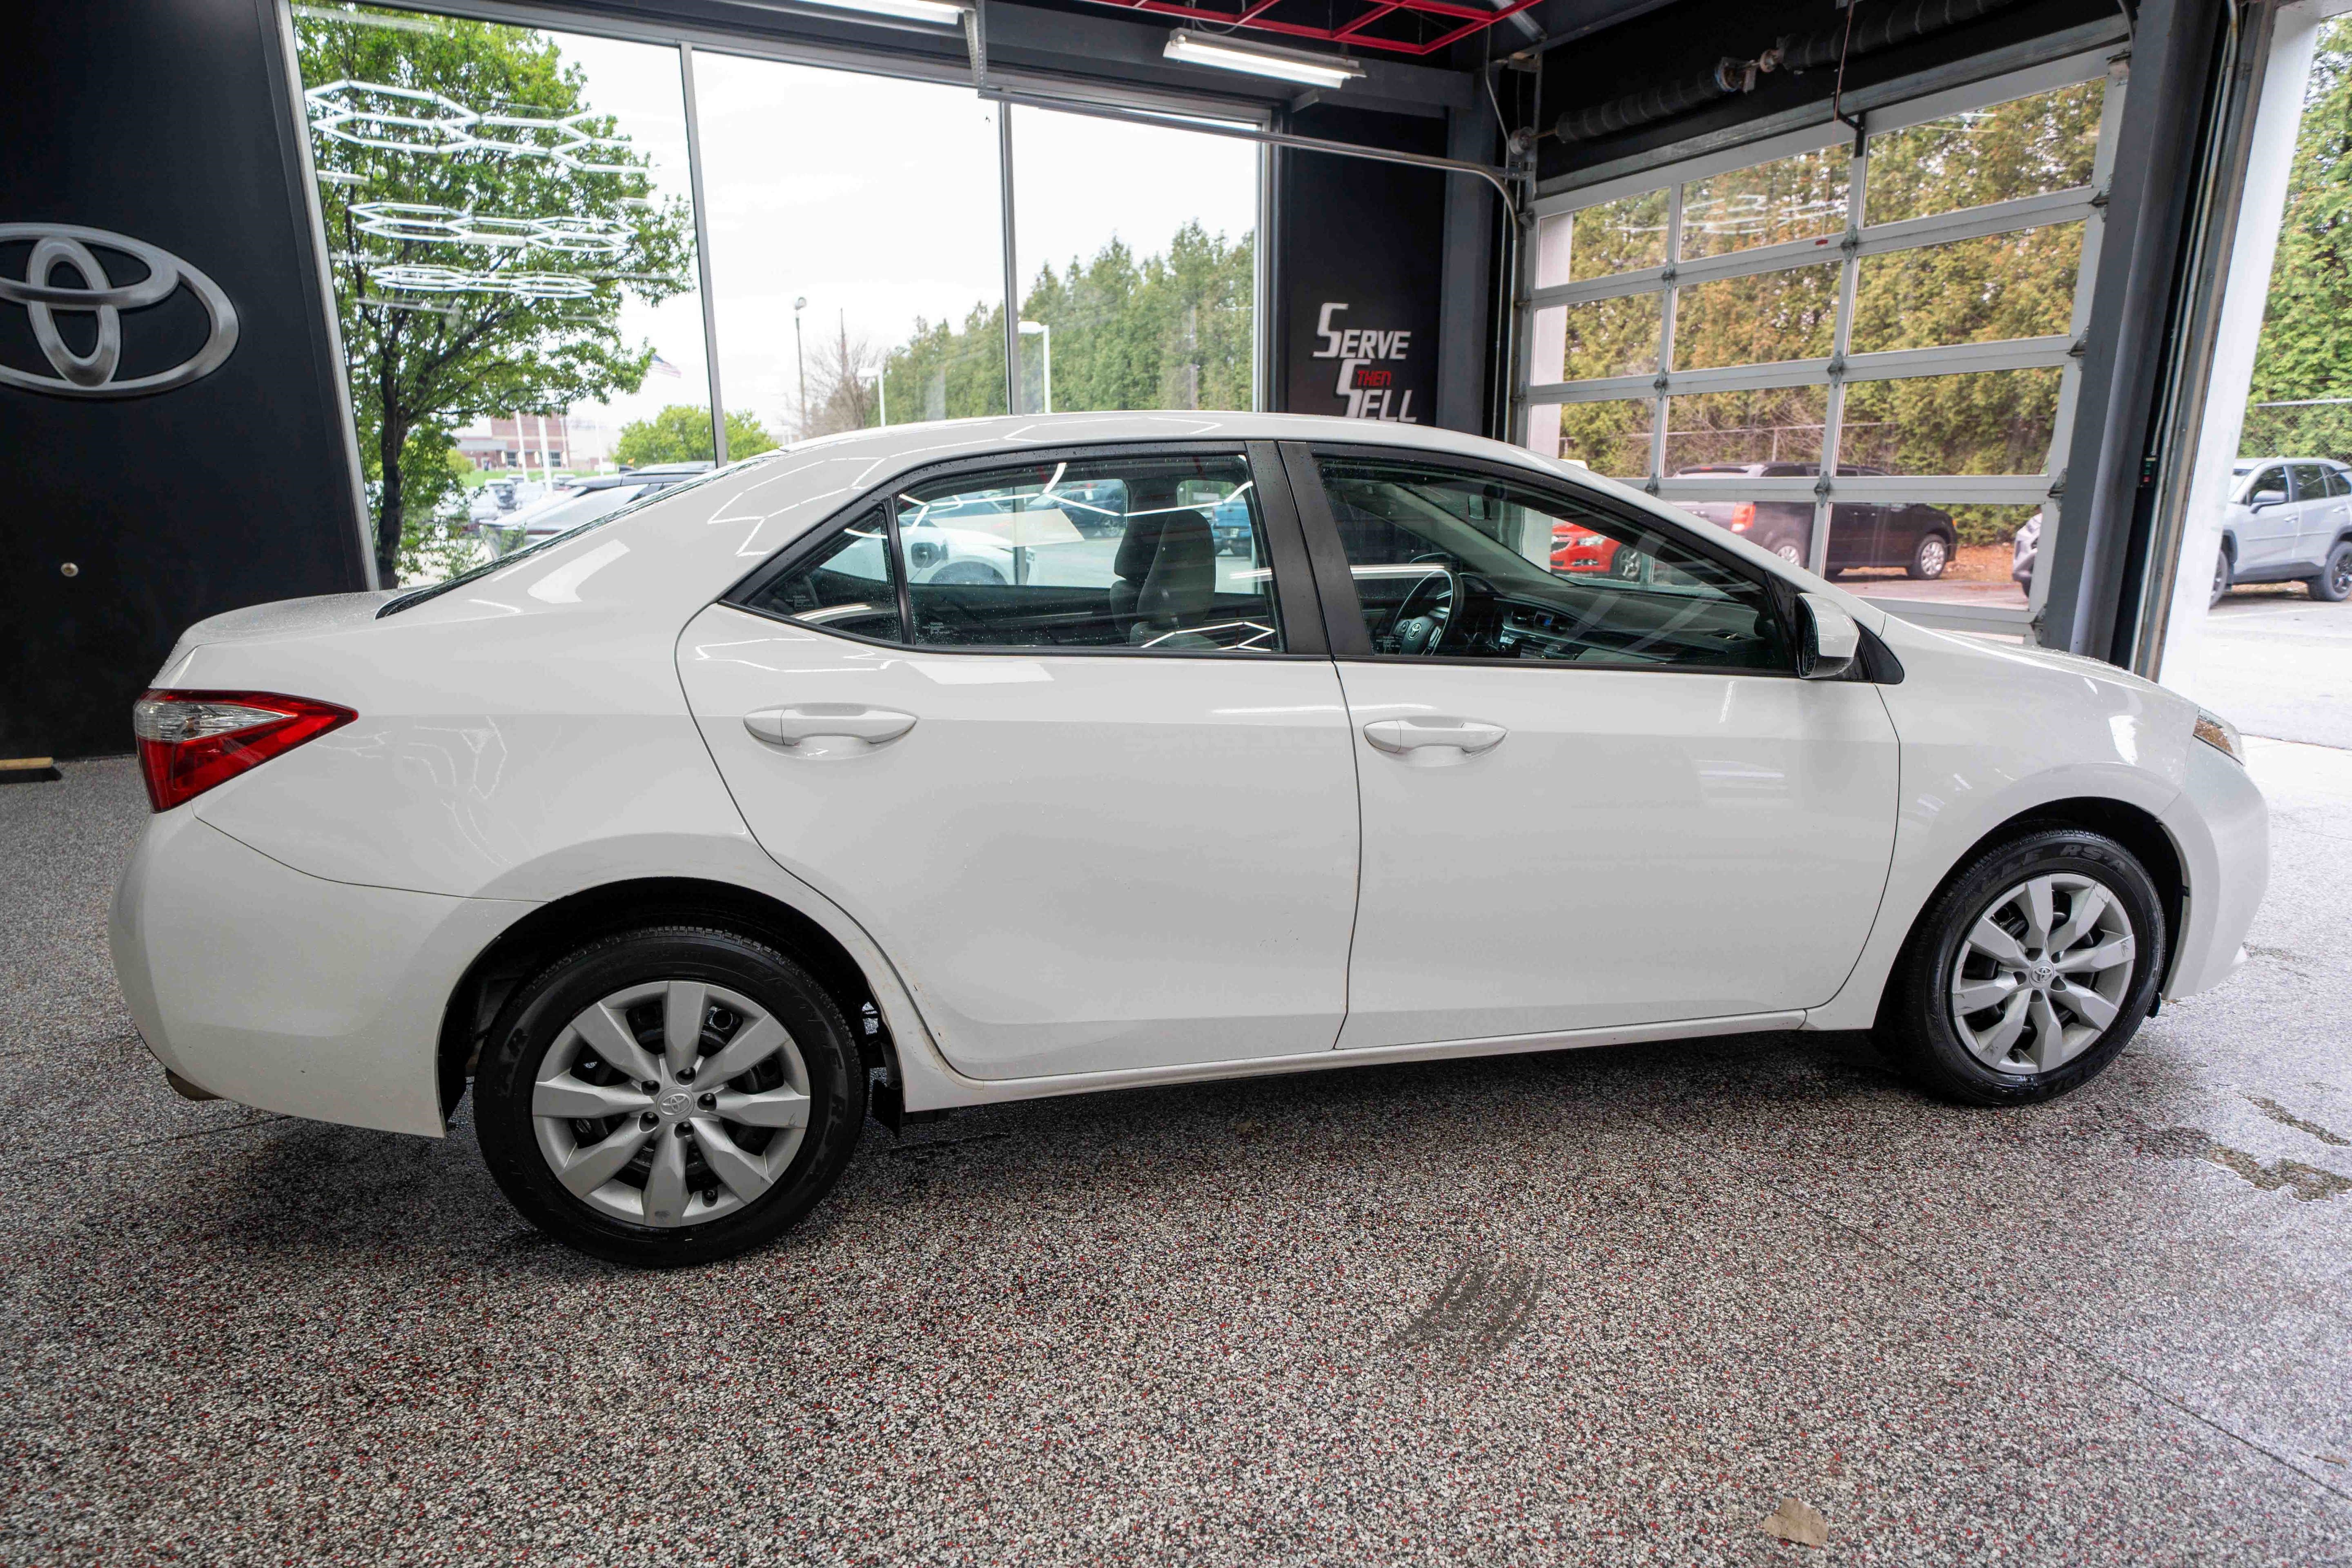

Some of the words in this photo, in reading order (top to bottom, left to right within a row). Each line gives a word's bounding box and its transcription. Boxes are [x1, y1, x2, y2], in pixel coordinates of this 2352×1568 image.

[1312, 303, 1411, 359] SERVE
[1336, 359, 1417, 423] SELL
[1356, 370, 1392, 386] THEN
